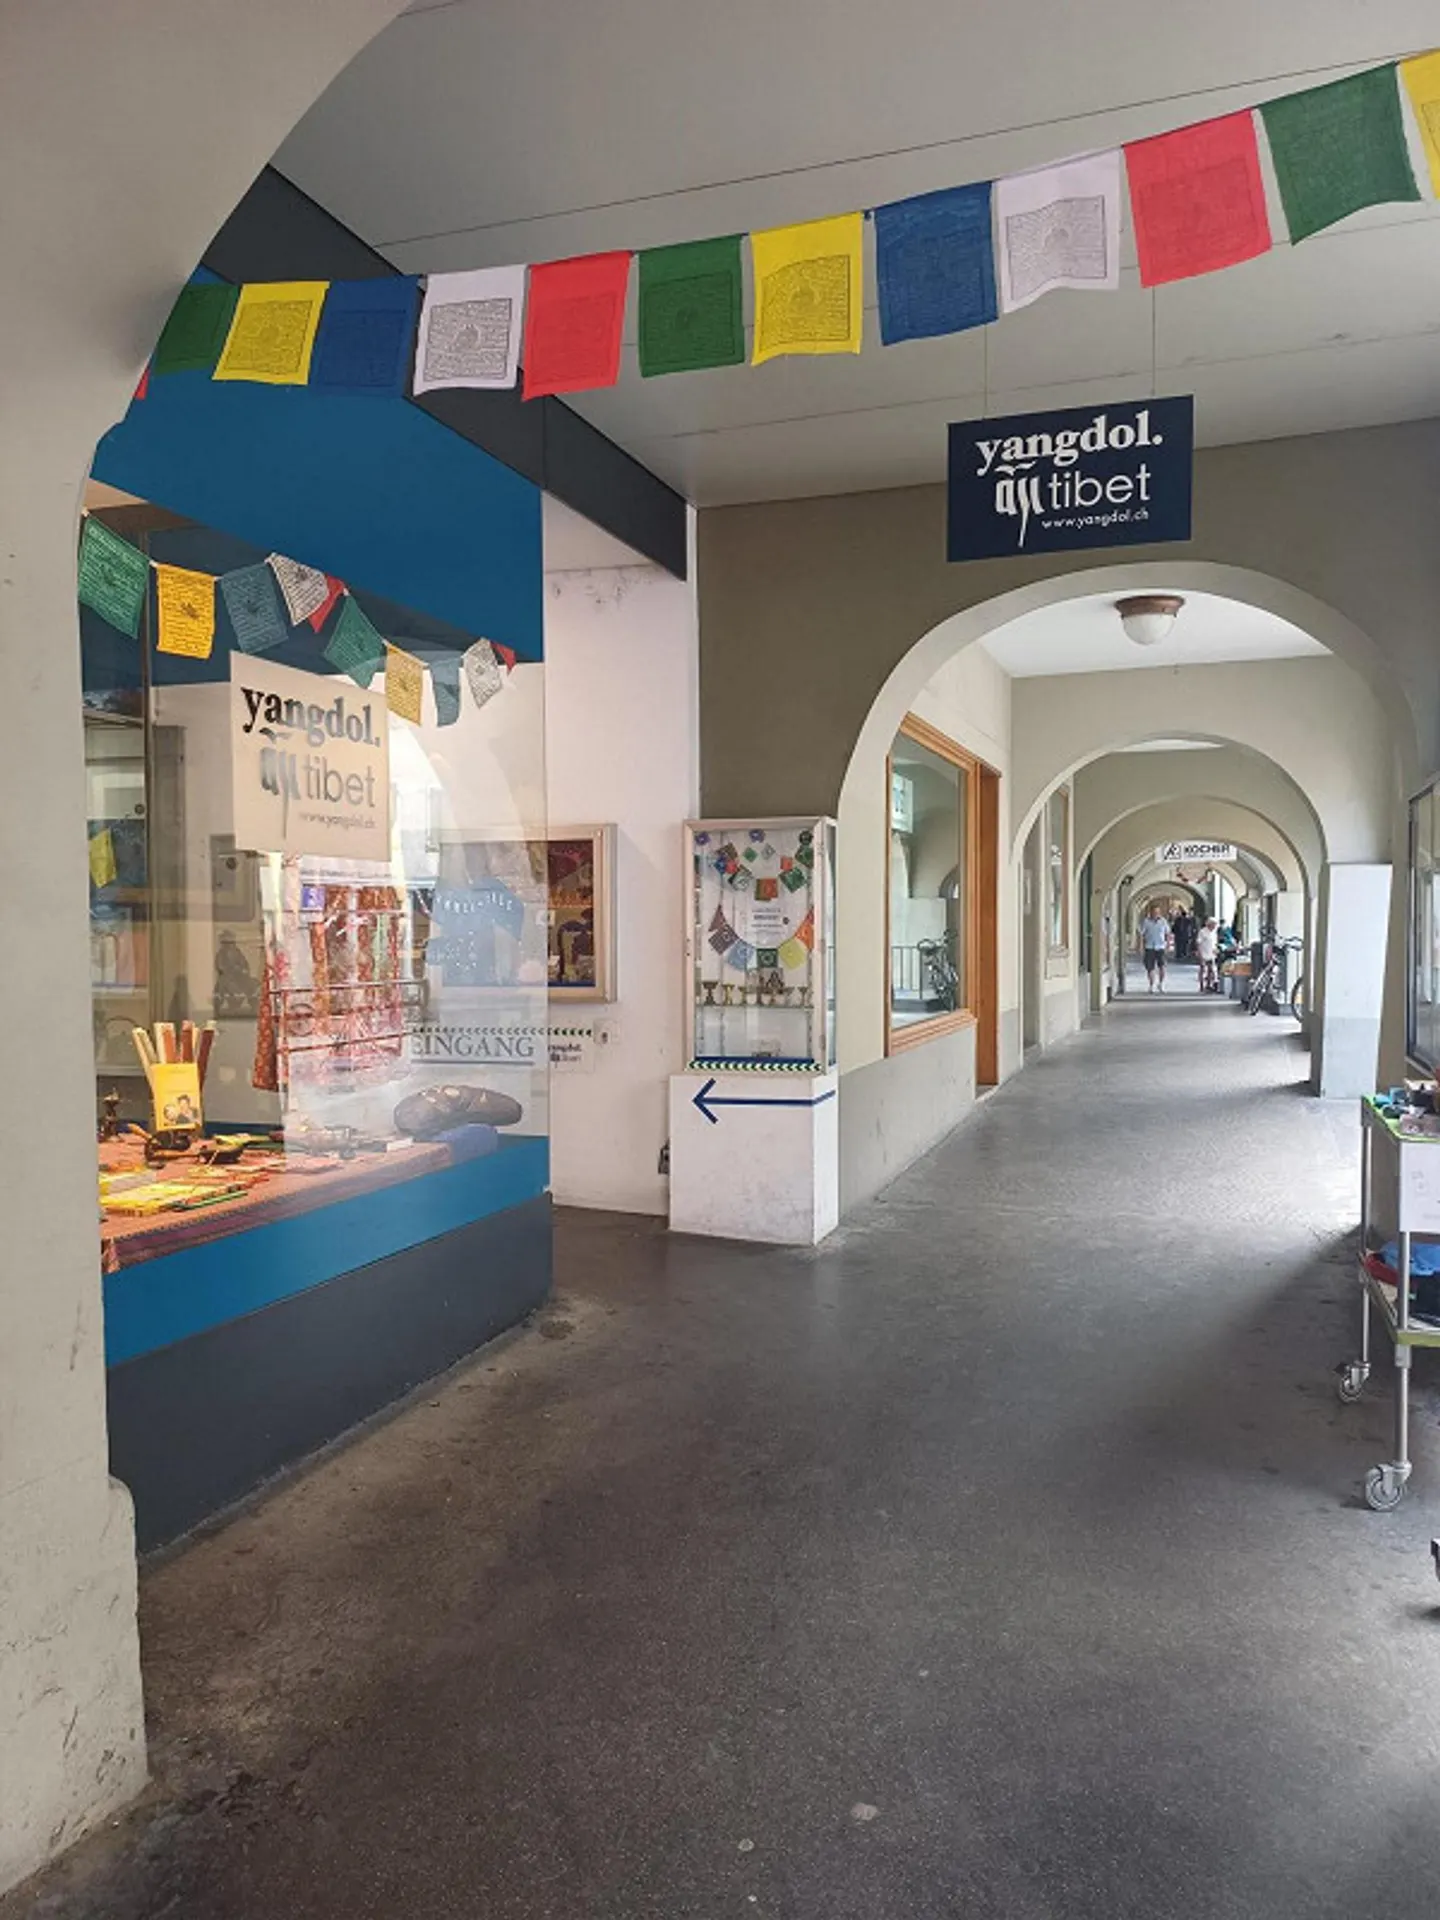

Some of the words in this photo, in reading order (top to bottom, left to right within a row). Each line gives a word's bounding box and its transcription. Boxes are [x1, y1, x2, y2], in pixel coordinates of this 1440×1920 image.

[975, 409, 1163, 477] yangdol.
[1048, 463, 1152, 510] tibet
[1041, 507, 1150, 530] www.yangdol.ch
[240, 686, 381, 748] yangdol.
[302, 755, 376, 808] tibet
[411, 1034, 535, 1058] EINGANG
